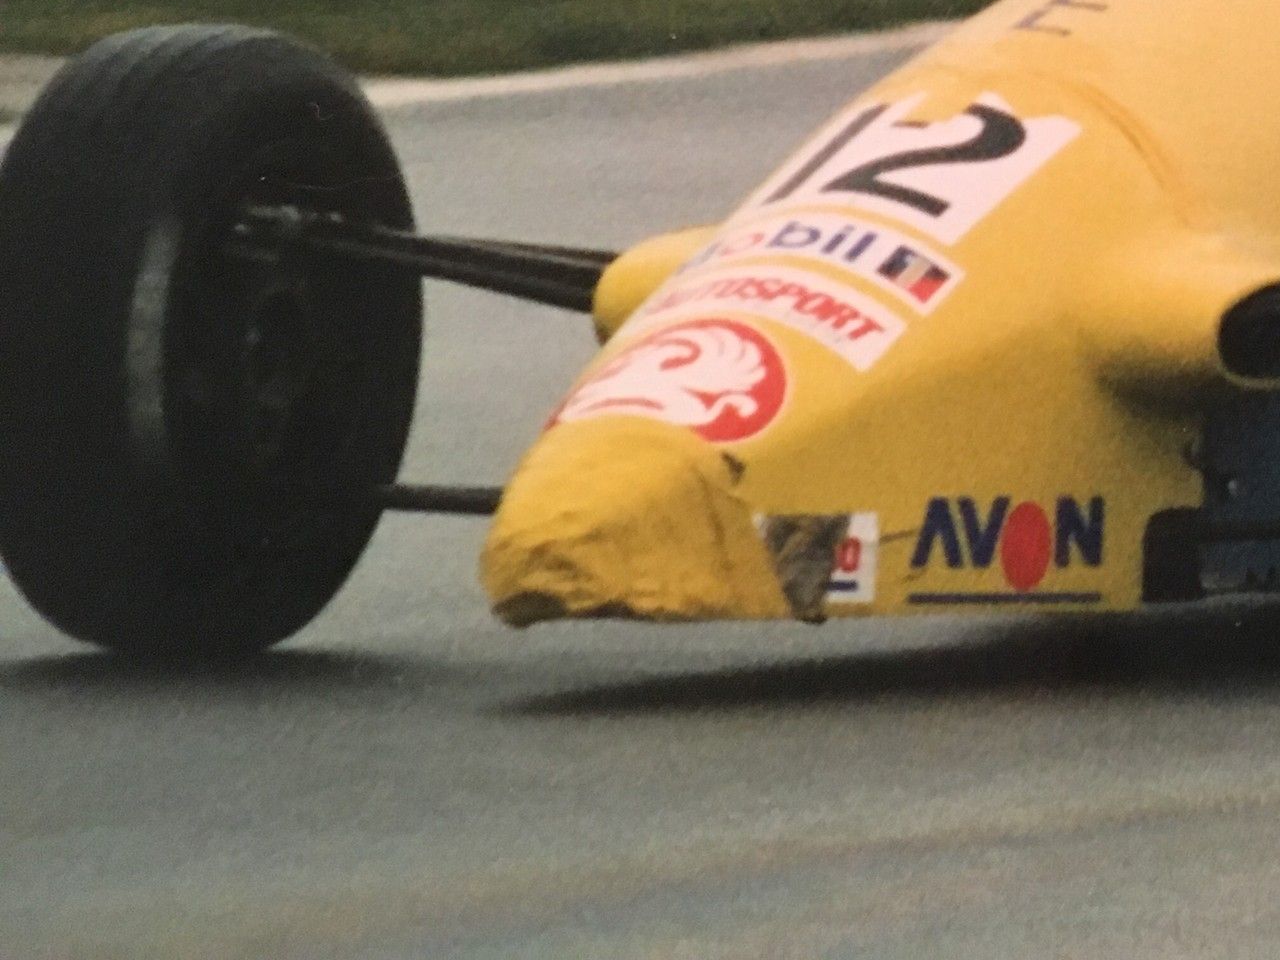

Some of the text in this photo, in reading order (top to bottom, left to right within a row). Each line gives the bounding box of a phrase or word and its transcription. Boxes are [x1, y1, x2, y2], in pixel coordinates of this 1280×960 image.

[760, 102, 1027, 218] 12
[674, 220, 877, 276] obil
[908, 495, 1105, 592] AVON
